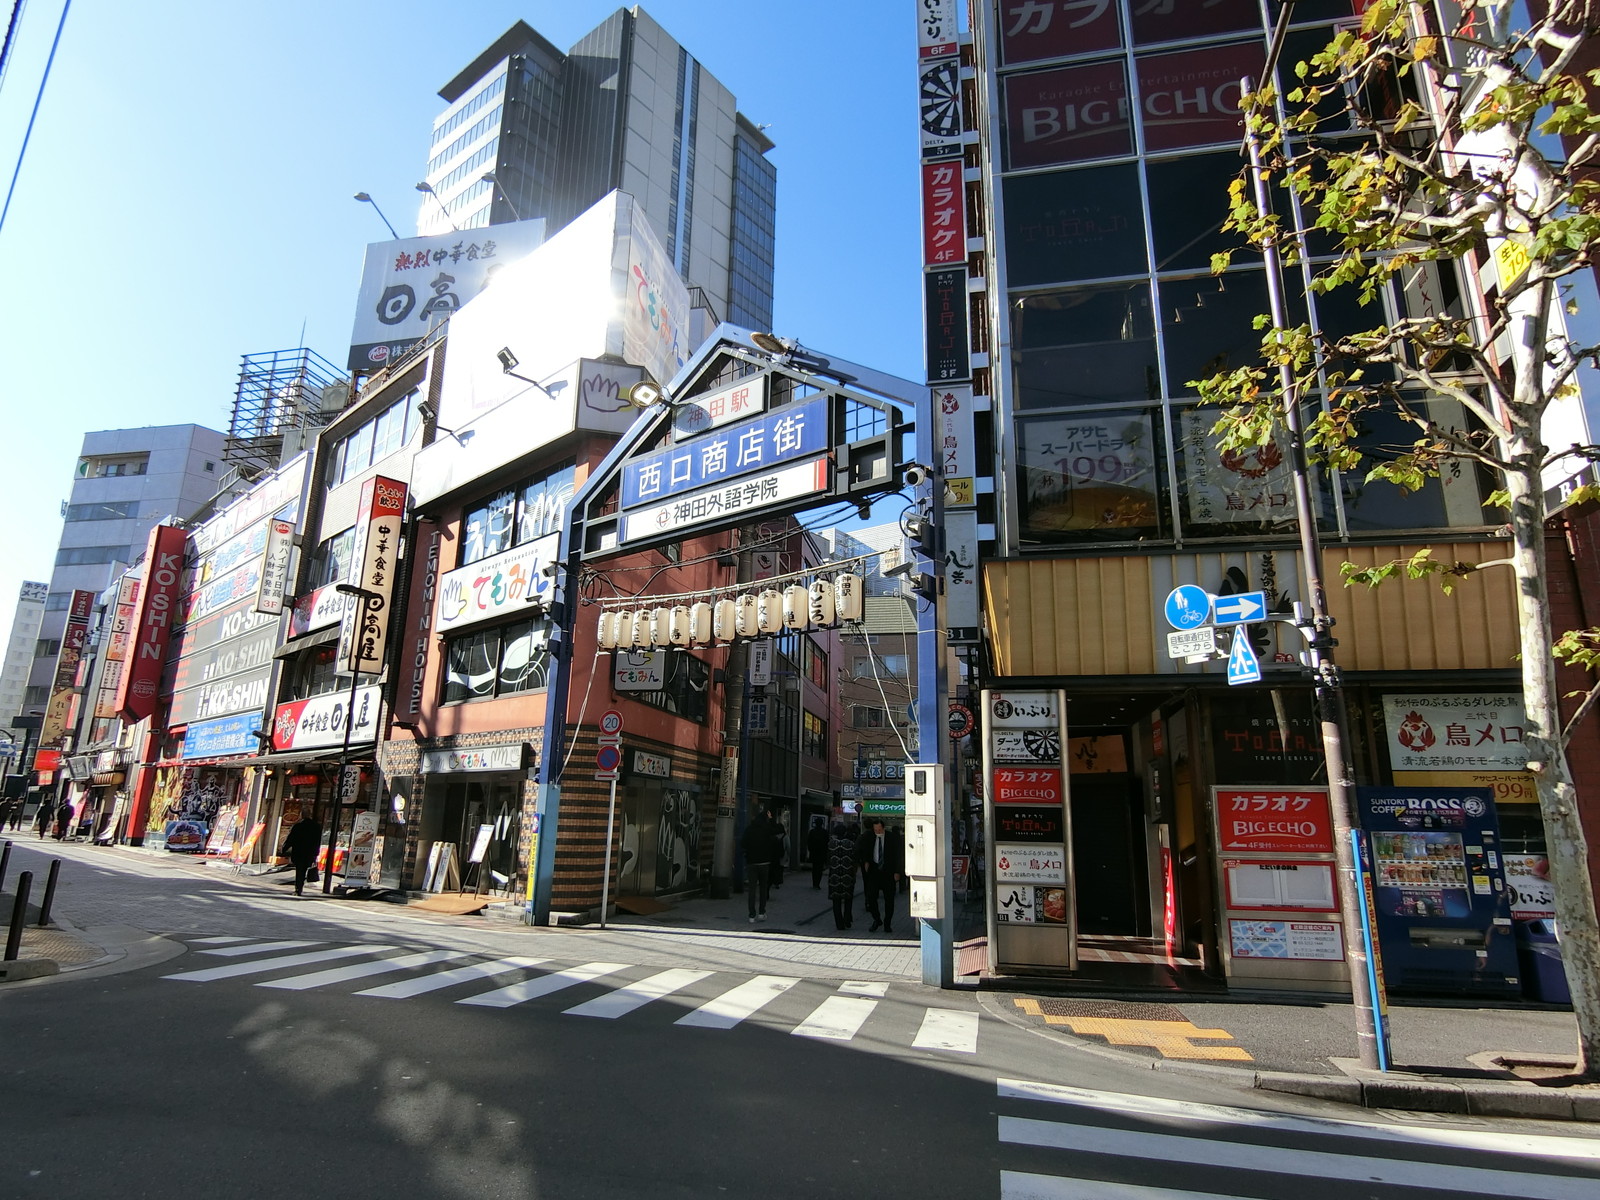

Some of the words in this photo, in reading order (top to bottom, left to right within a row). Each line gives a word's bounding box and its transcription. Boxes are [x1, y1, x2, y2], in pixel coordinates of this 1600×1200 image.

[931, 45, 946, 55] 6F
[931, 167, 956, 247] カラオケ
[934, 249, 955, 261] 4F
[940, 369, 957, 379] 3F
[687, 387, 750, 425] 神田駅
[1066, 426, 1108, 439] アサヒ
[638, 413, 805, 499] 西口商店街
[943, 435, 958, 475] 鳥メロ
[378, 483, 403, 497] ちょい
[379, 496, 400, 509] 飲み
[673, 476, 779, 525] 神田外語学院
[1225, 493, 1287, 511] 鳥メロ
[371, 524, 392, 587] 中華食堂
[418, 530, 441, 632] TEMOMIN
[473, 556, 549, 610] てもみん
[841, 575, 852, 597] 神田駅
[142, 552, 181, 660] KO-SHIN
[263, 600, 278, 608] 3F
[810, 581, 825, 622] れとろ
[1170, 630, 1212, 645] 自転車通行可
[1172, 641, 1213, 655] ここから
[408, 637, 428, 715] HOUSE
[617, 669, 661, 683] てもみん
[206, 678, 270, 716] KO-SHIN
[1014, 705, 1051, 718] いぶり
[1465, 712, 1499, 720] 三代目
[605, 717, 619, 729] 20
[997, 737, 1022, 746] ダーツ
[1445, 722, 1524, 747] 鳥メロ
[461, 753, 488, 769] てもみん
[1000, 771, 1053, 782] カラオケ
[1000, 788, 1022, 799] BIG
[1023, 789, 1056, 800] ECHO
[1231, 795, 1312, 811] カラオケ
[1233, 821, 1265, 836] BIG
[1268, 821, 1317, 837] ECHO
[1029, 859, 1062, 870] 鳥メロ
